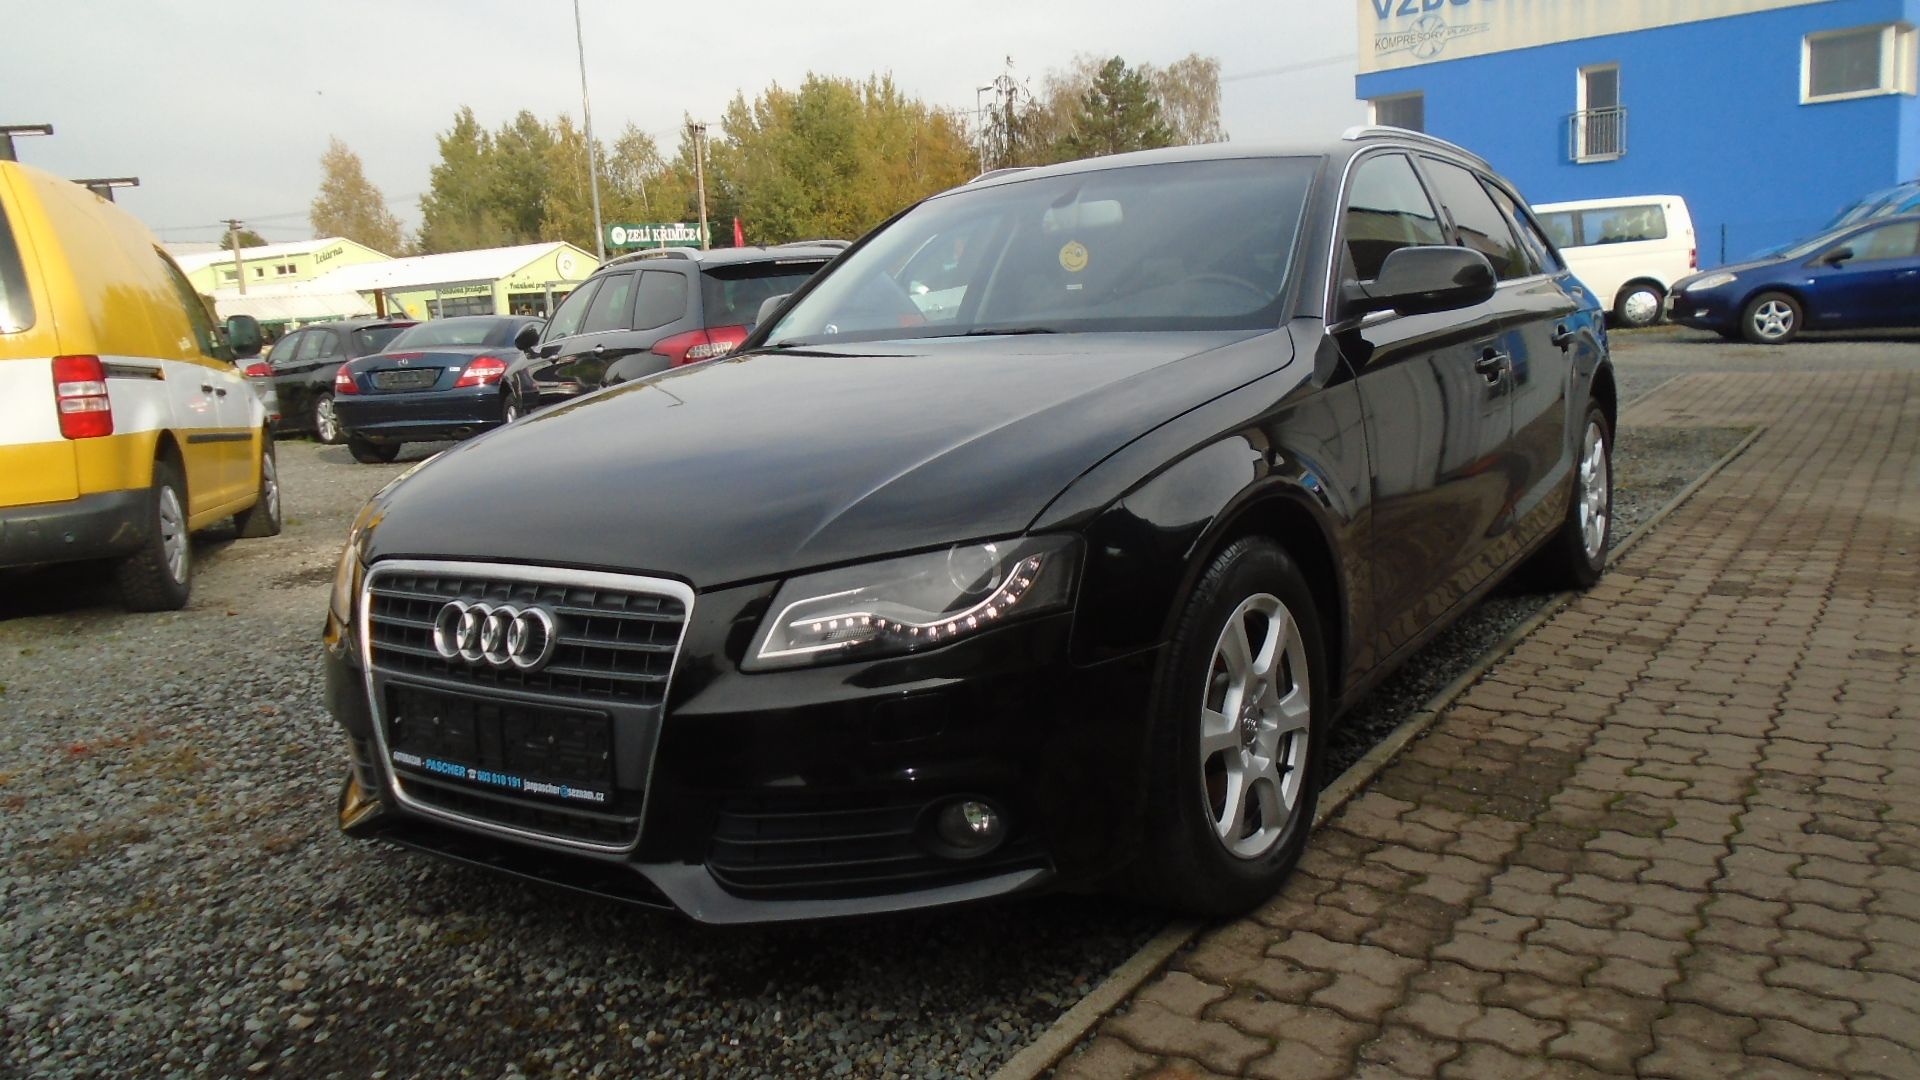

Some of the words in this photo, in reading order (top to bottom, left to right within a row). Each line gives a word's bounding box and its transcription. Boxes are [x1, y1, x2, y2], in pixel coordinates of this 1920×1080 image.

[1374, 31, 1445, 50] KOMPRESORY
[627, 225, 651, 242] ZELÍ
[425, 758, 466, 777] PASCHER
[507, 776, 521, 789] 191
